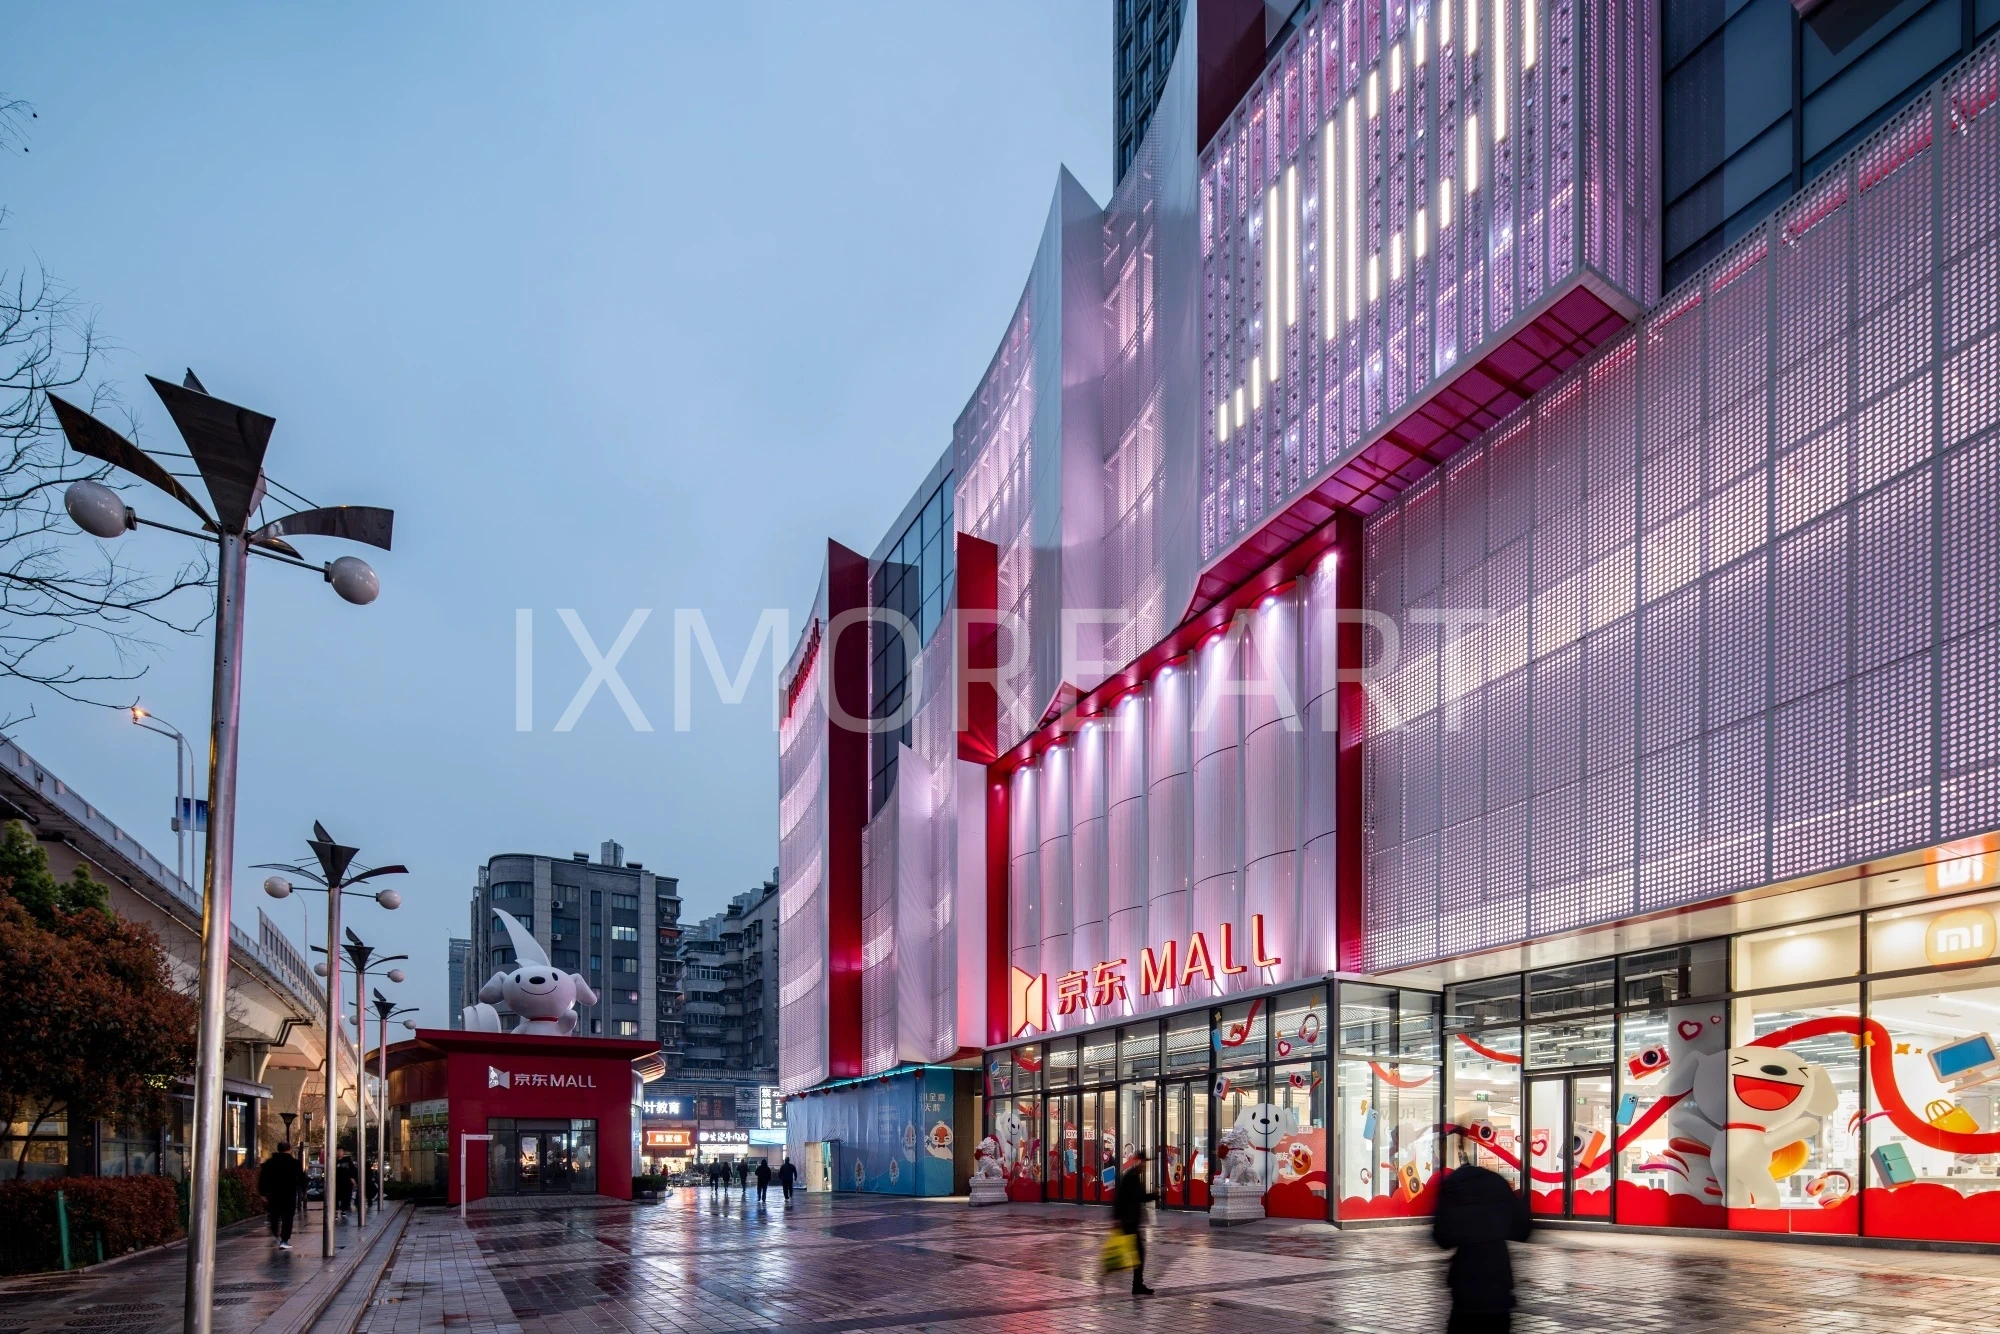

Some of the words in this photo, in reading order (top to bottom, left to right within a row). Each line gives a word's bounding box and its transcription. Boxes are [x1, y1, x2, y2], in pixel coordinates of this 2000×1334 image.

[1056, 958, 1127, 1015] 京东
[1139, 913, 1281, 996] MALL
[643, 1101, 680, 1114] 计教育
